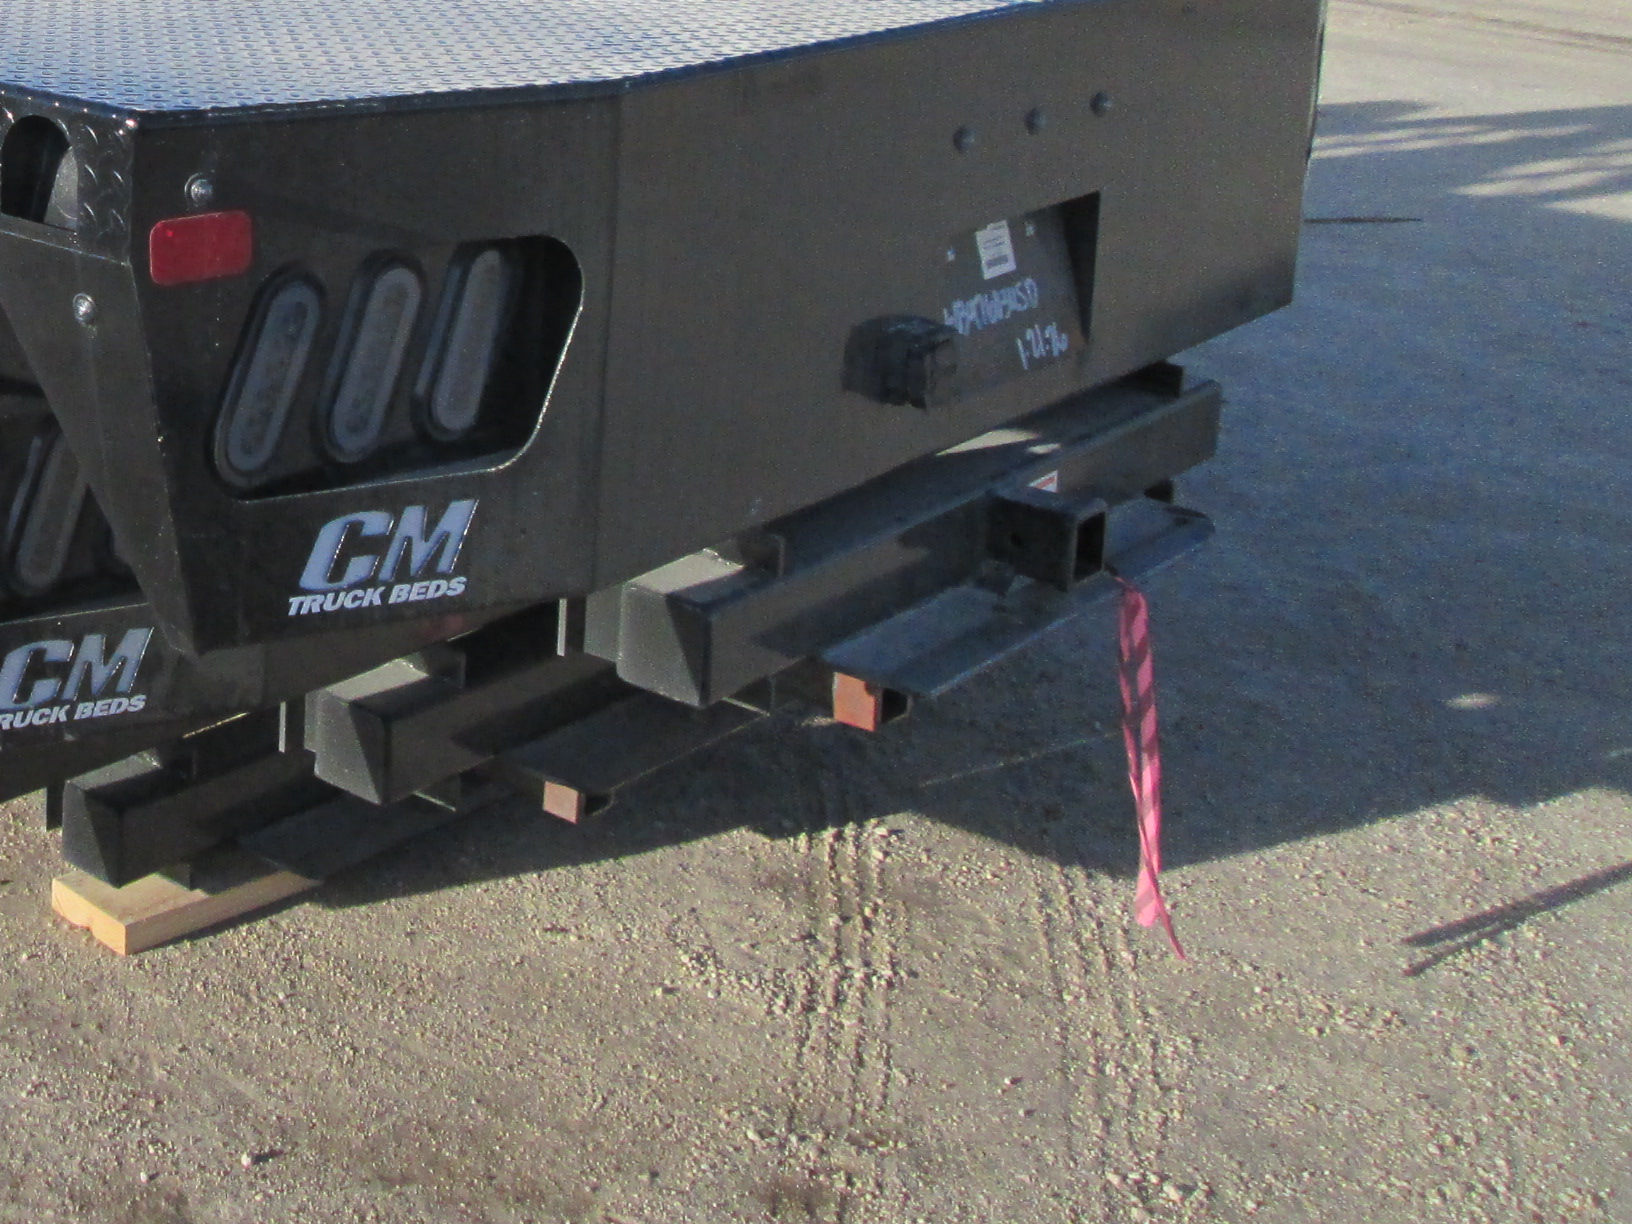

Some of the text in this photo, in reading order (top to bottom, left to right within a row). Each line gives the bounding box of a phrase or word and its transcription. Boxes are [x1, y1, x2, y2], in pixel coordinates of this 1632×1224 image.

[298, 499, 480, 591] CM
[287, 576, 468, 616] TRUCK BEDS
[73, 694, 147, 720] BEDS
